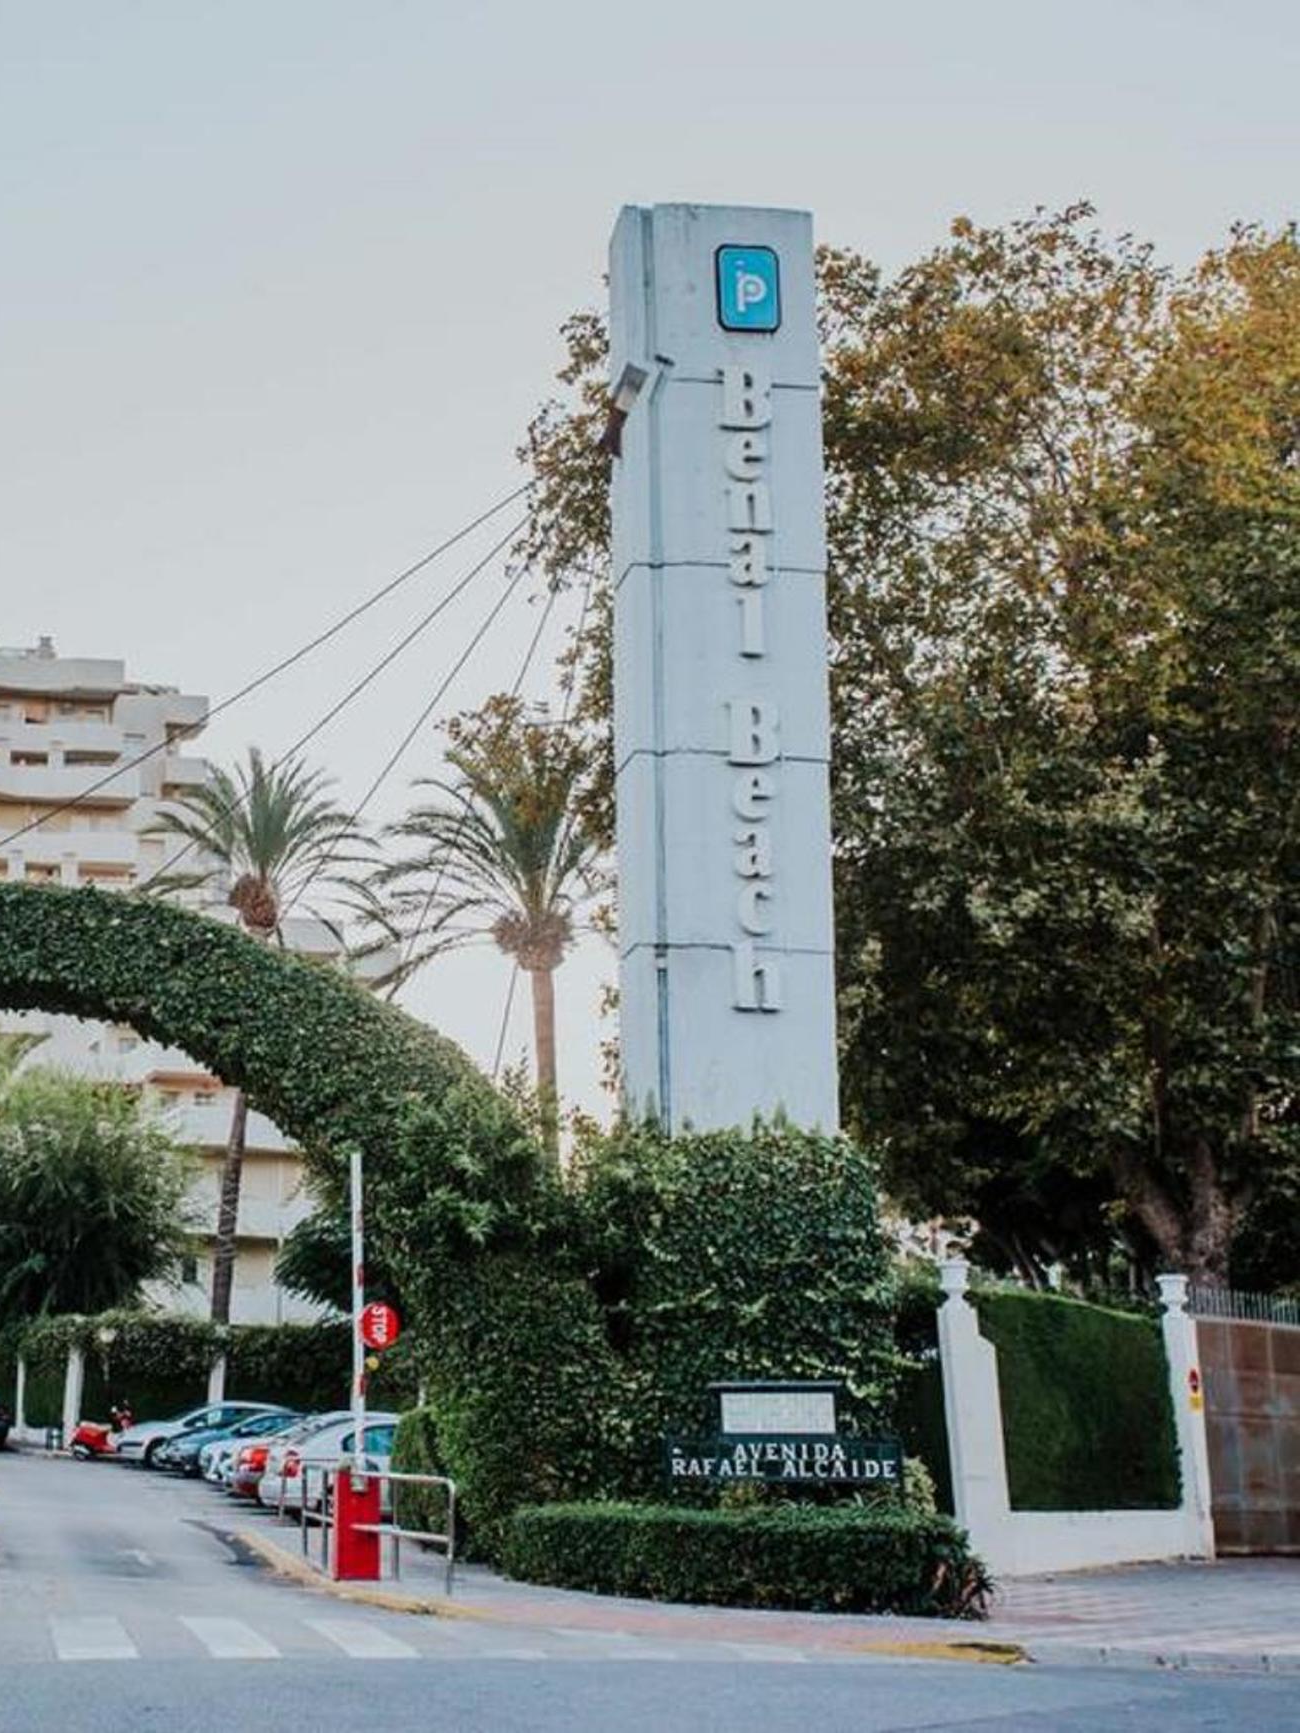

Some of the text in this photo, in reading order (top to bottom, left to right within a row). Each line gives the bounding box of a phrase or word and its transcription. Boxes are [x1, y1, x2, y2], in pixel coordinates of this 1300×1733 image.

[719, 364, 781, 1013] Benal Beach
[371, 1305, 388, 1344] STOP
[733, 1443, 847, 1461] AVENIDA
[671, 1458, 897, 1478] RAFAEL ALCAIDE
